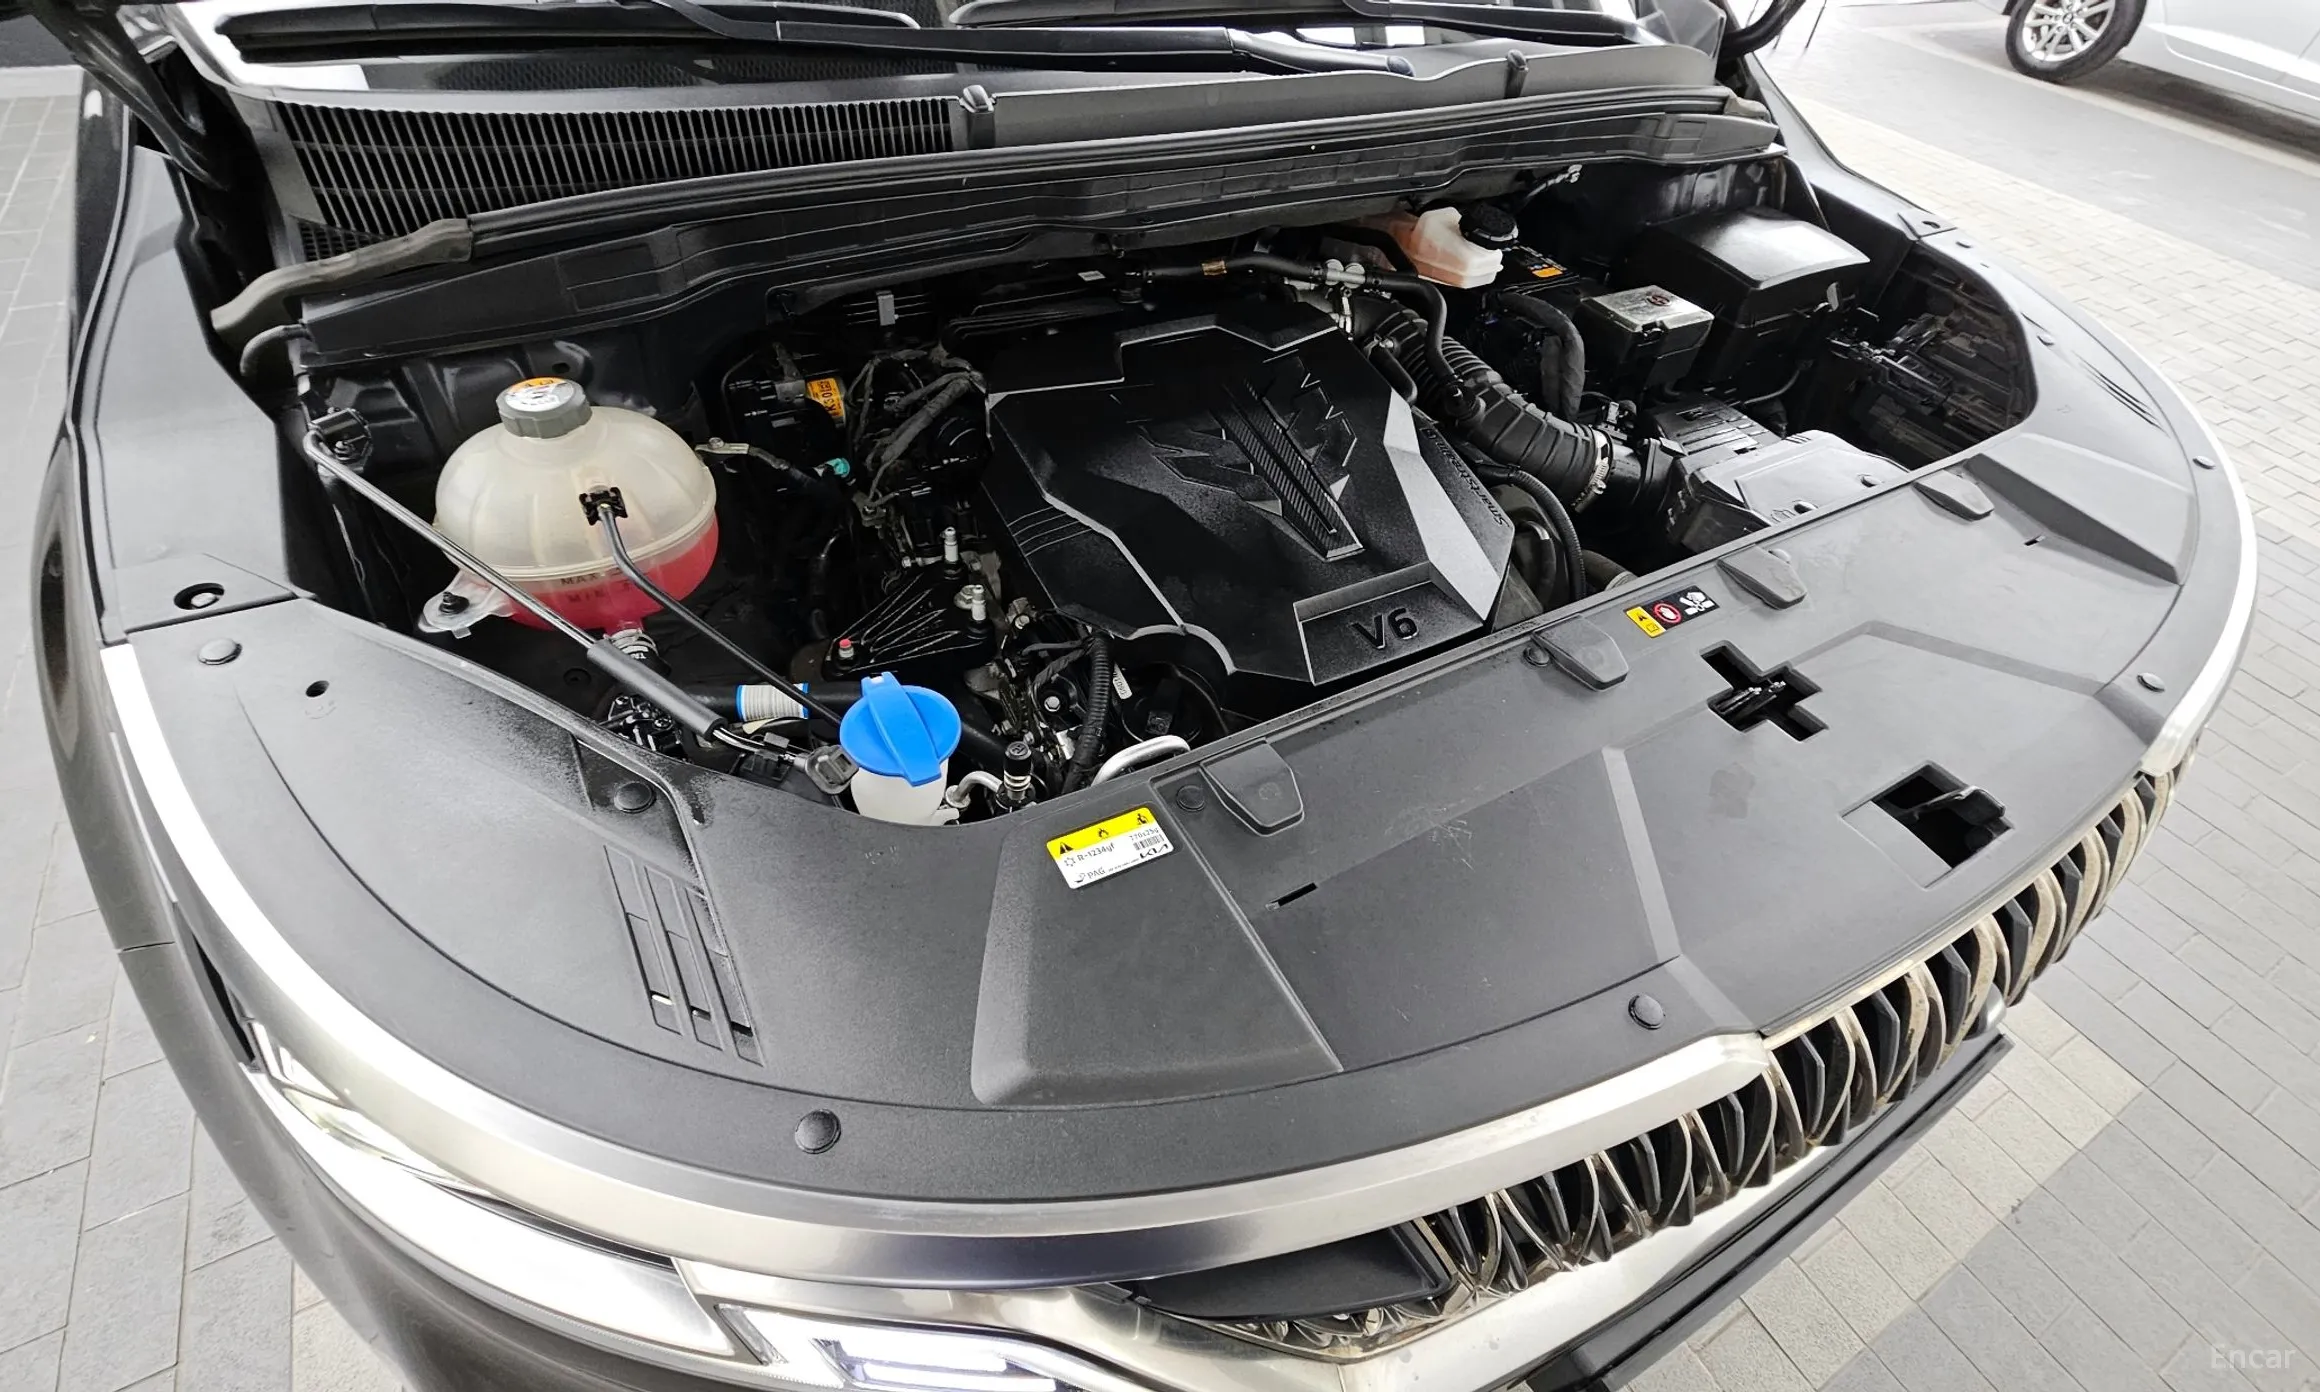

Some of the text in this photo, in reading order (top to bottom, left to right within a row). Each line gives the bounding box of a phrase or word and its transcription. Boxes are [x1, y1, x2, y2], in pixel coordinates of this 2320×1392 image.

[561, 573, 598, 586] MAX
[1350, 607, 1419, 650] V6
[1077, 842, 1115, 862] R-1234yf
[1087, 867, 1106, 879] PAG
